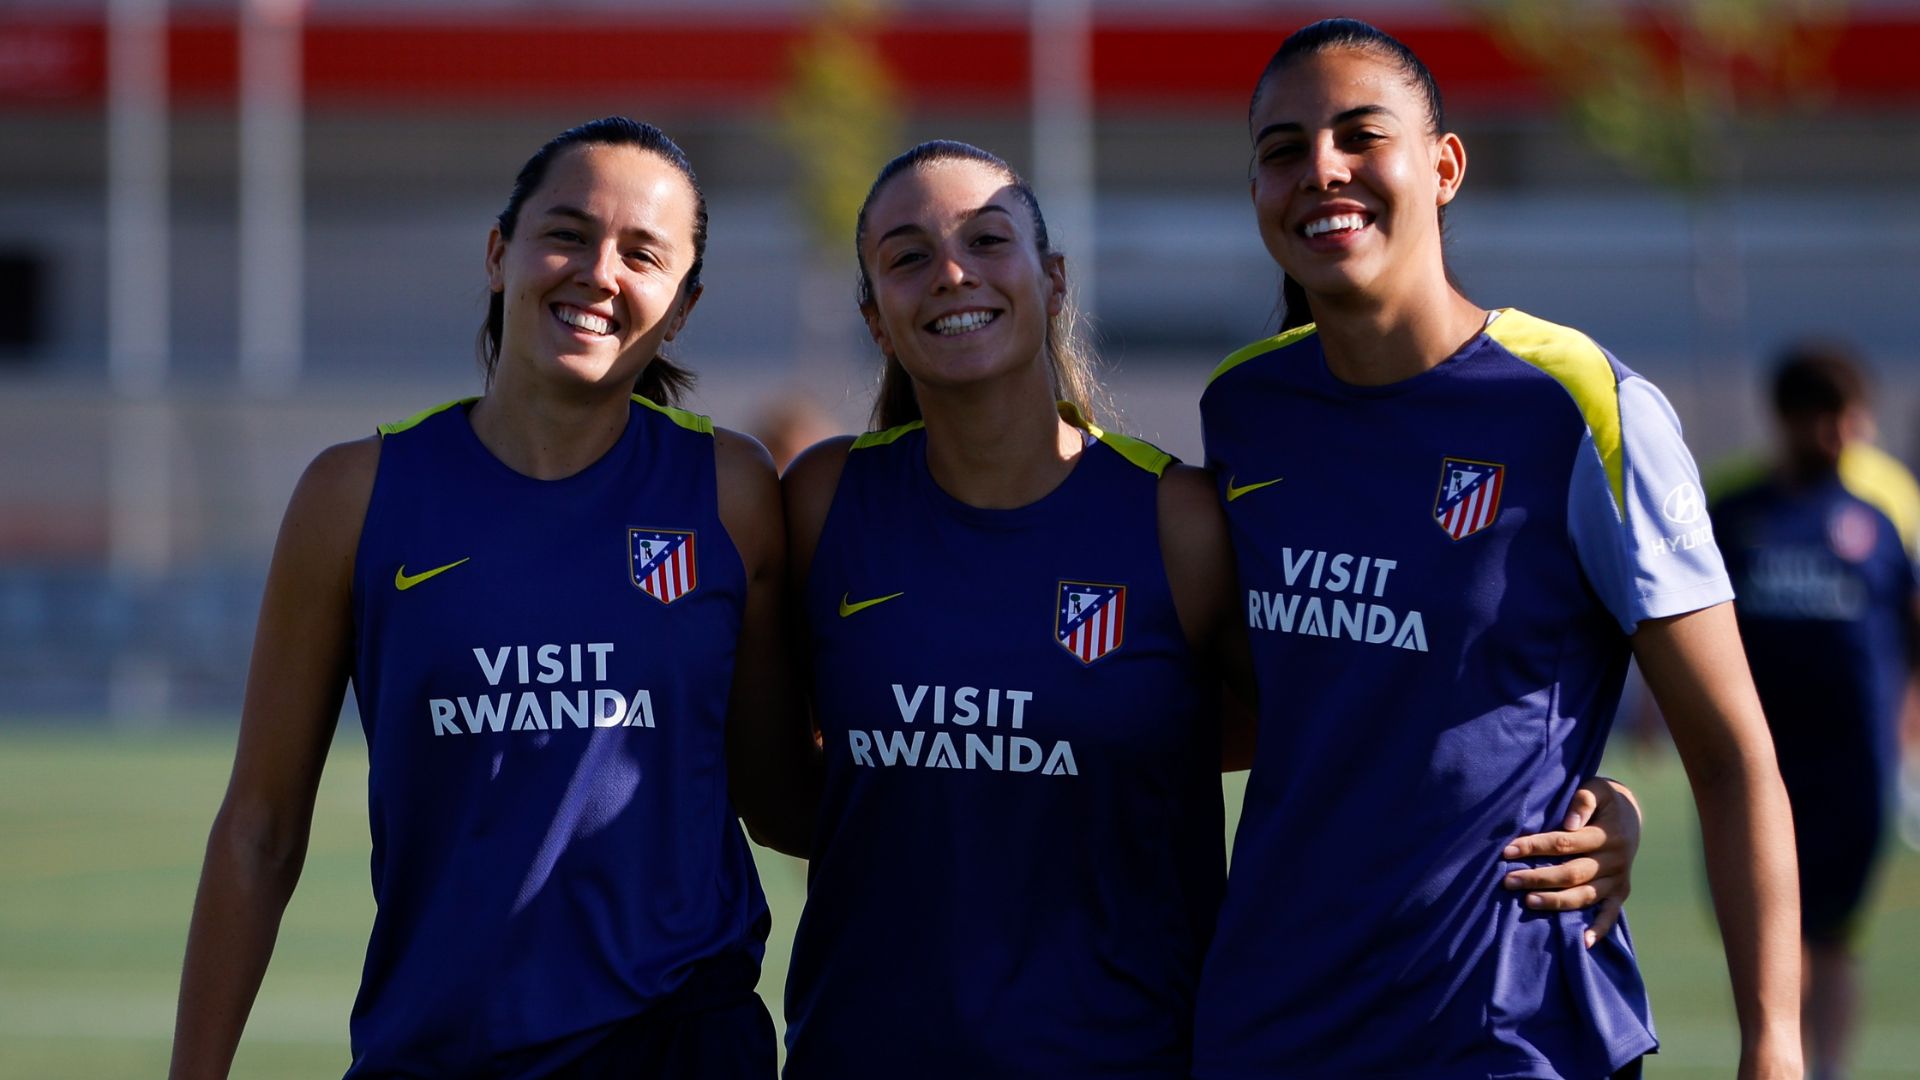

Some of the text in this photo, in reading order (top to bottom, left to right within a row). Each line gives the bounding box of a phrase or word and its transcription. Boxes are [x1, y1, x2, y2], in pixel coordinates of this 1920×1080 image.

[1651, 526, 1712, 556] HYUND
[1282, 547, 1398, 597] VISIT
[1249, 589, 1429, 652] RWANDA
[472, 642, 615, 686] VISIT
[428, 688, 656, 737] RWANDA
[891, 683, 1033, 729] VISIT
[848, 729, 1079, 776] RWANDA
